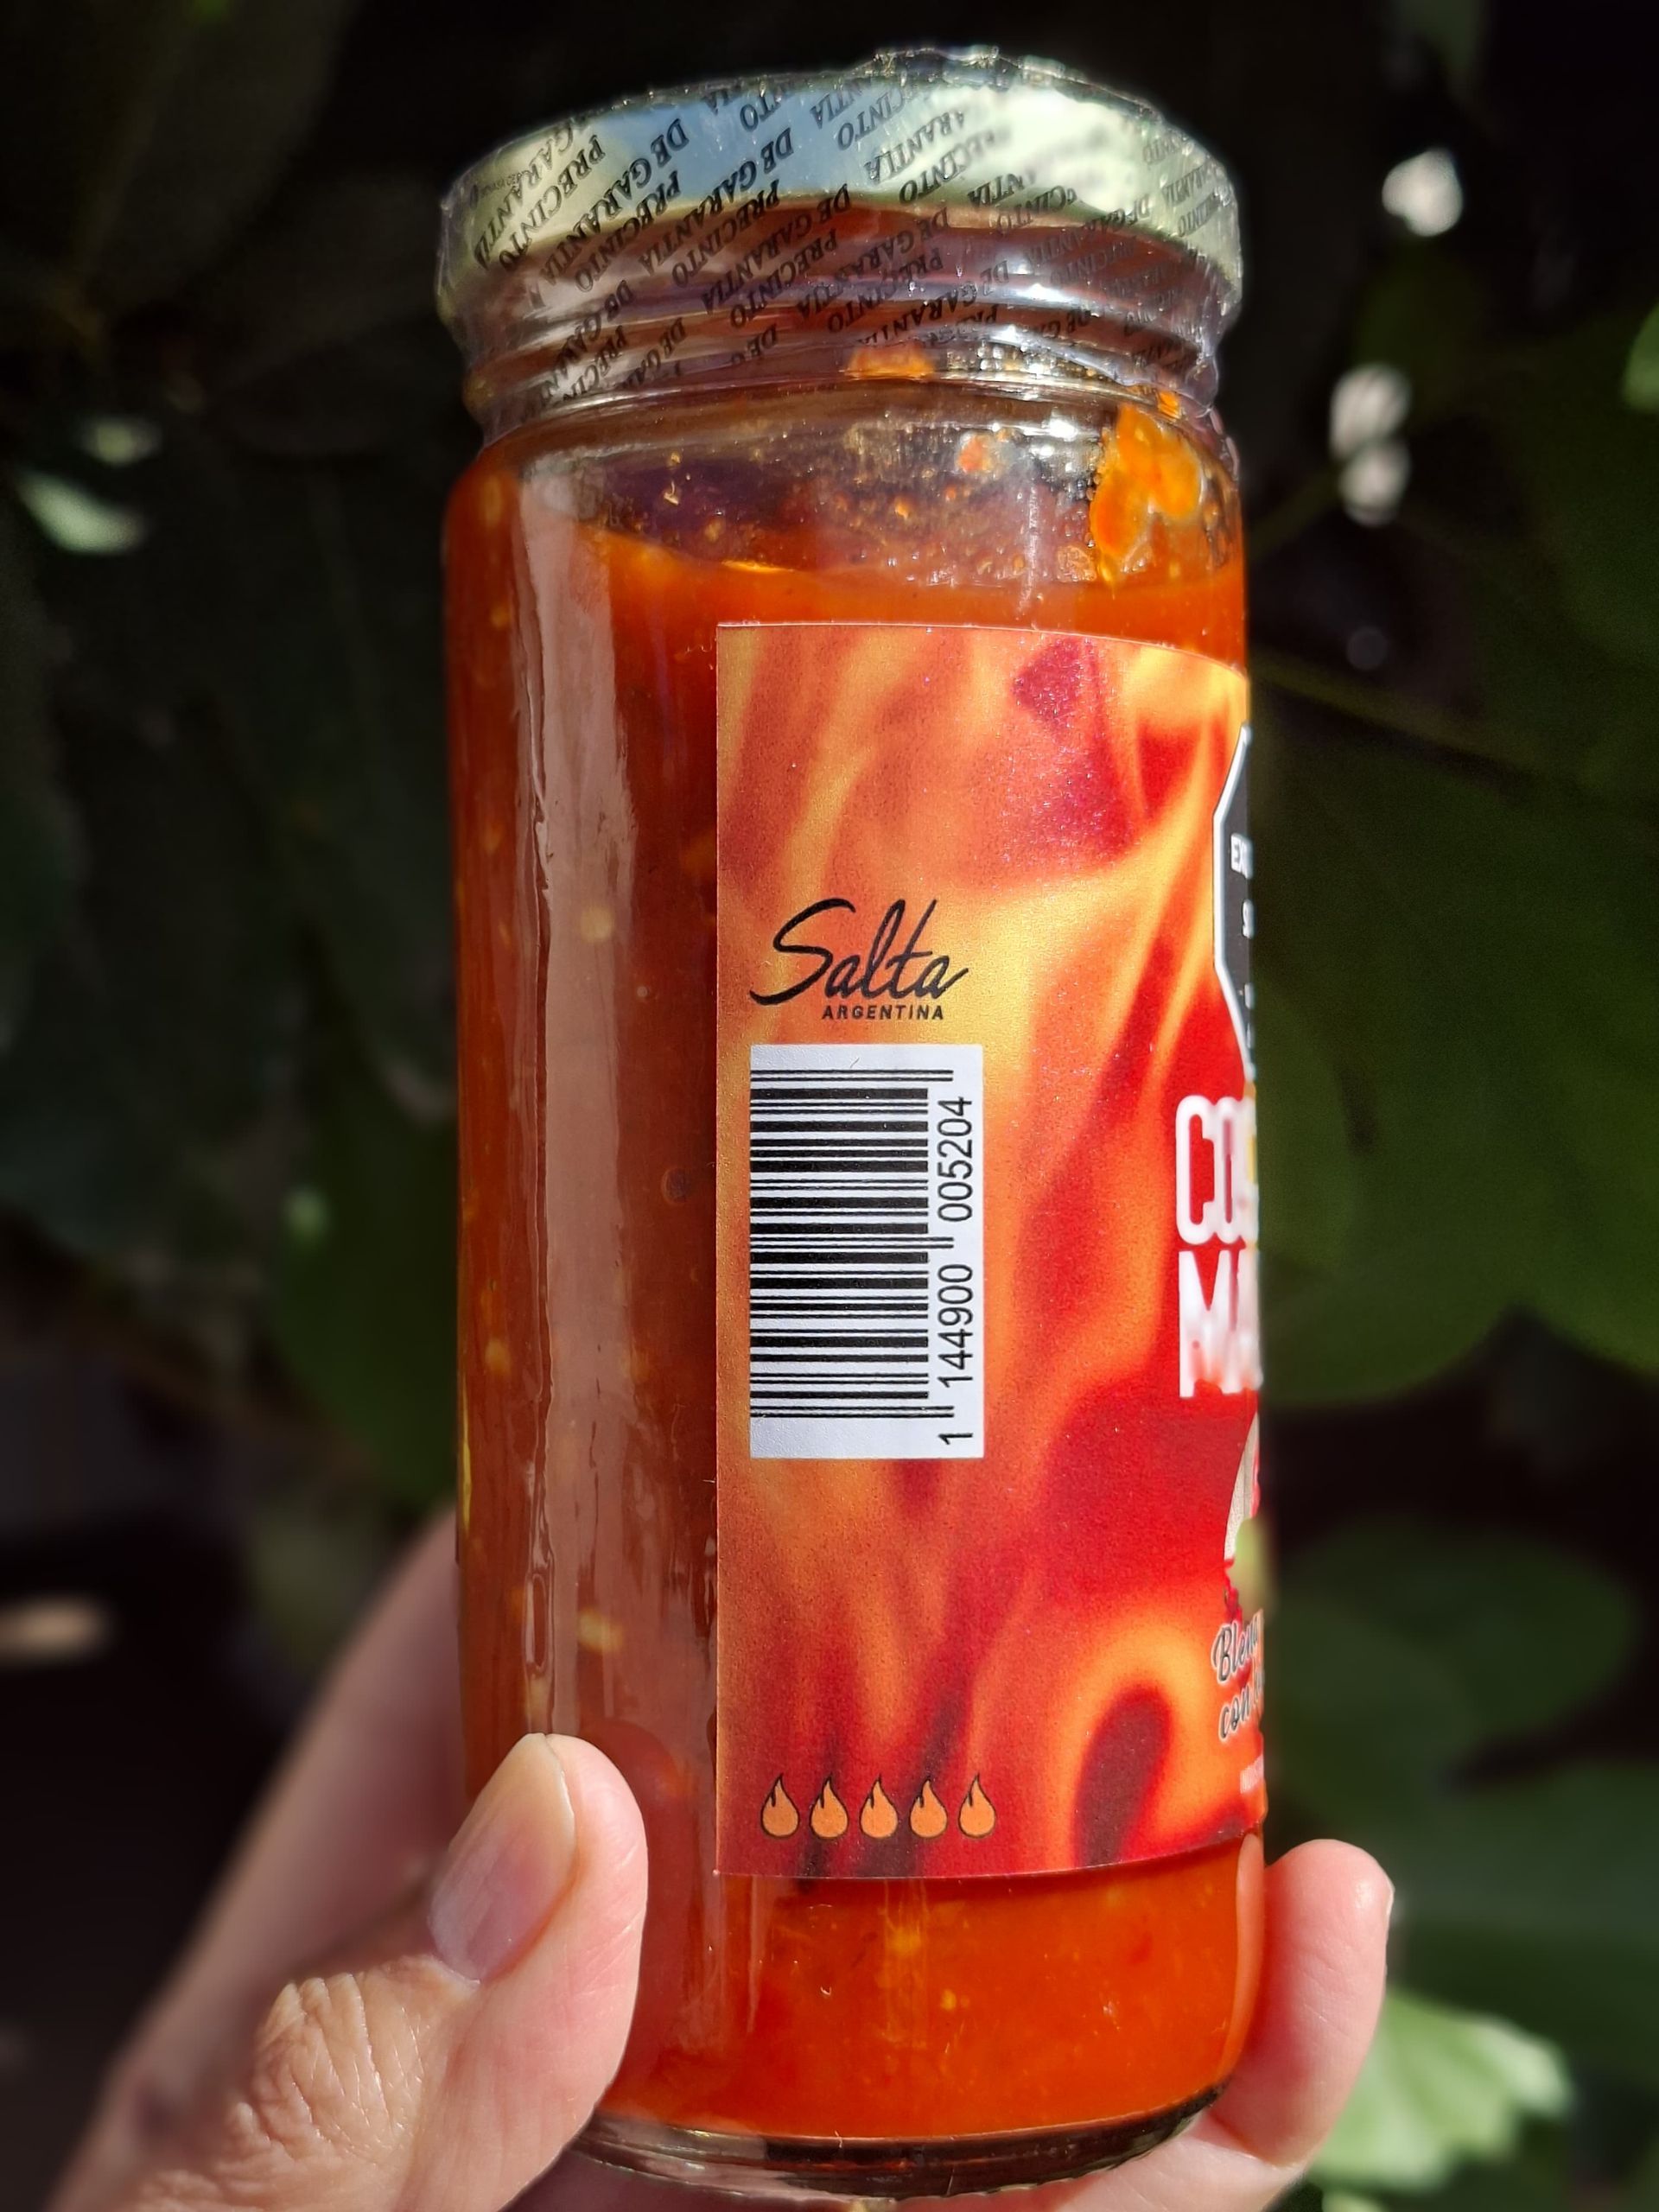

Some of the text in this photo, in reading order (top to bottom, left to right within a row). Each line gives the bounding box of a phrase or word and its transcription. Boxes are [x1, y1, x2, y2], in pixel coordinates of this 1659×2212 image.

[651, 118, 690, 168] DE
[864, 110, 965, 185] ARANTIA
[499, 135, 606, 271] PRECINTO
[540, 157, 652, 285] GARANTIA
[575, 170, 681, 292] PRECINTO
[638, 127, 794, 276] DE GARANTIA
[671, 179, 780, 289] PRECINTO
[700, 183, 851, 315] DE GARANTIA
[917, 207, 949, 244] DE
[729, 227, 839, 328] PRECINTO
[563, 324, 628, 401] PRECIN
[749, 898, 969, 1006] Salta
[823, 1005, 944, 1020] ARGENTINA
[1175, 1095, 1257, 1245] CO
[938, 1096, 975, 1446] 1 144900 005204
